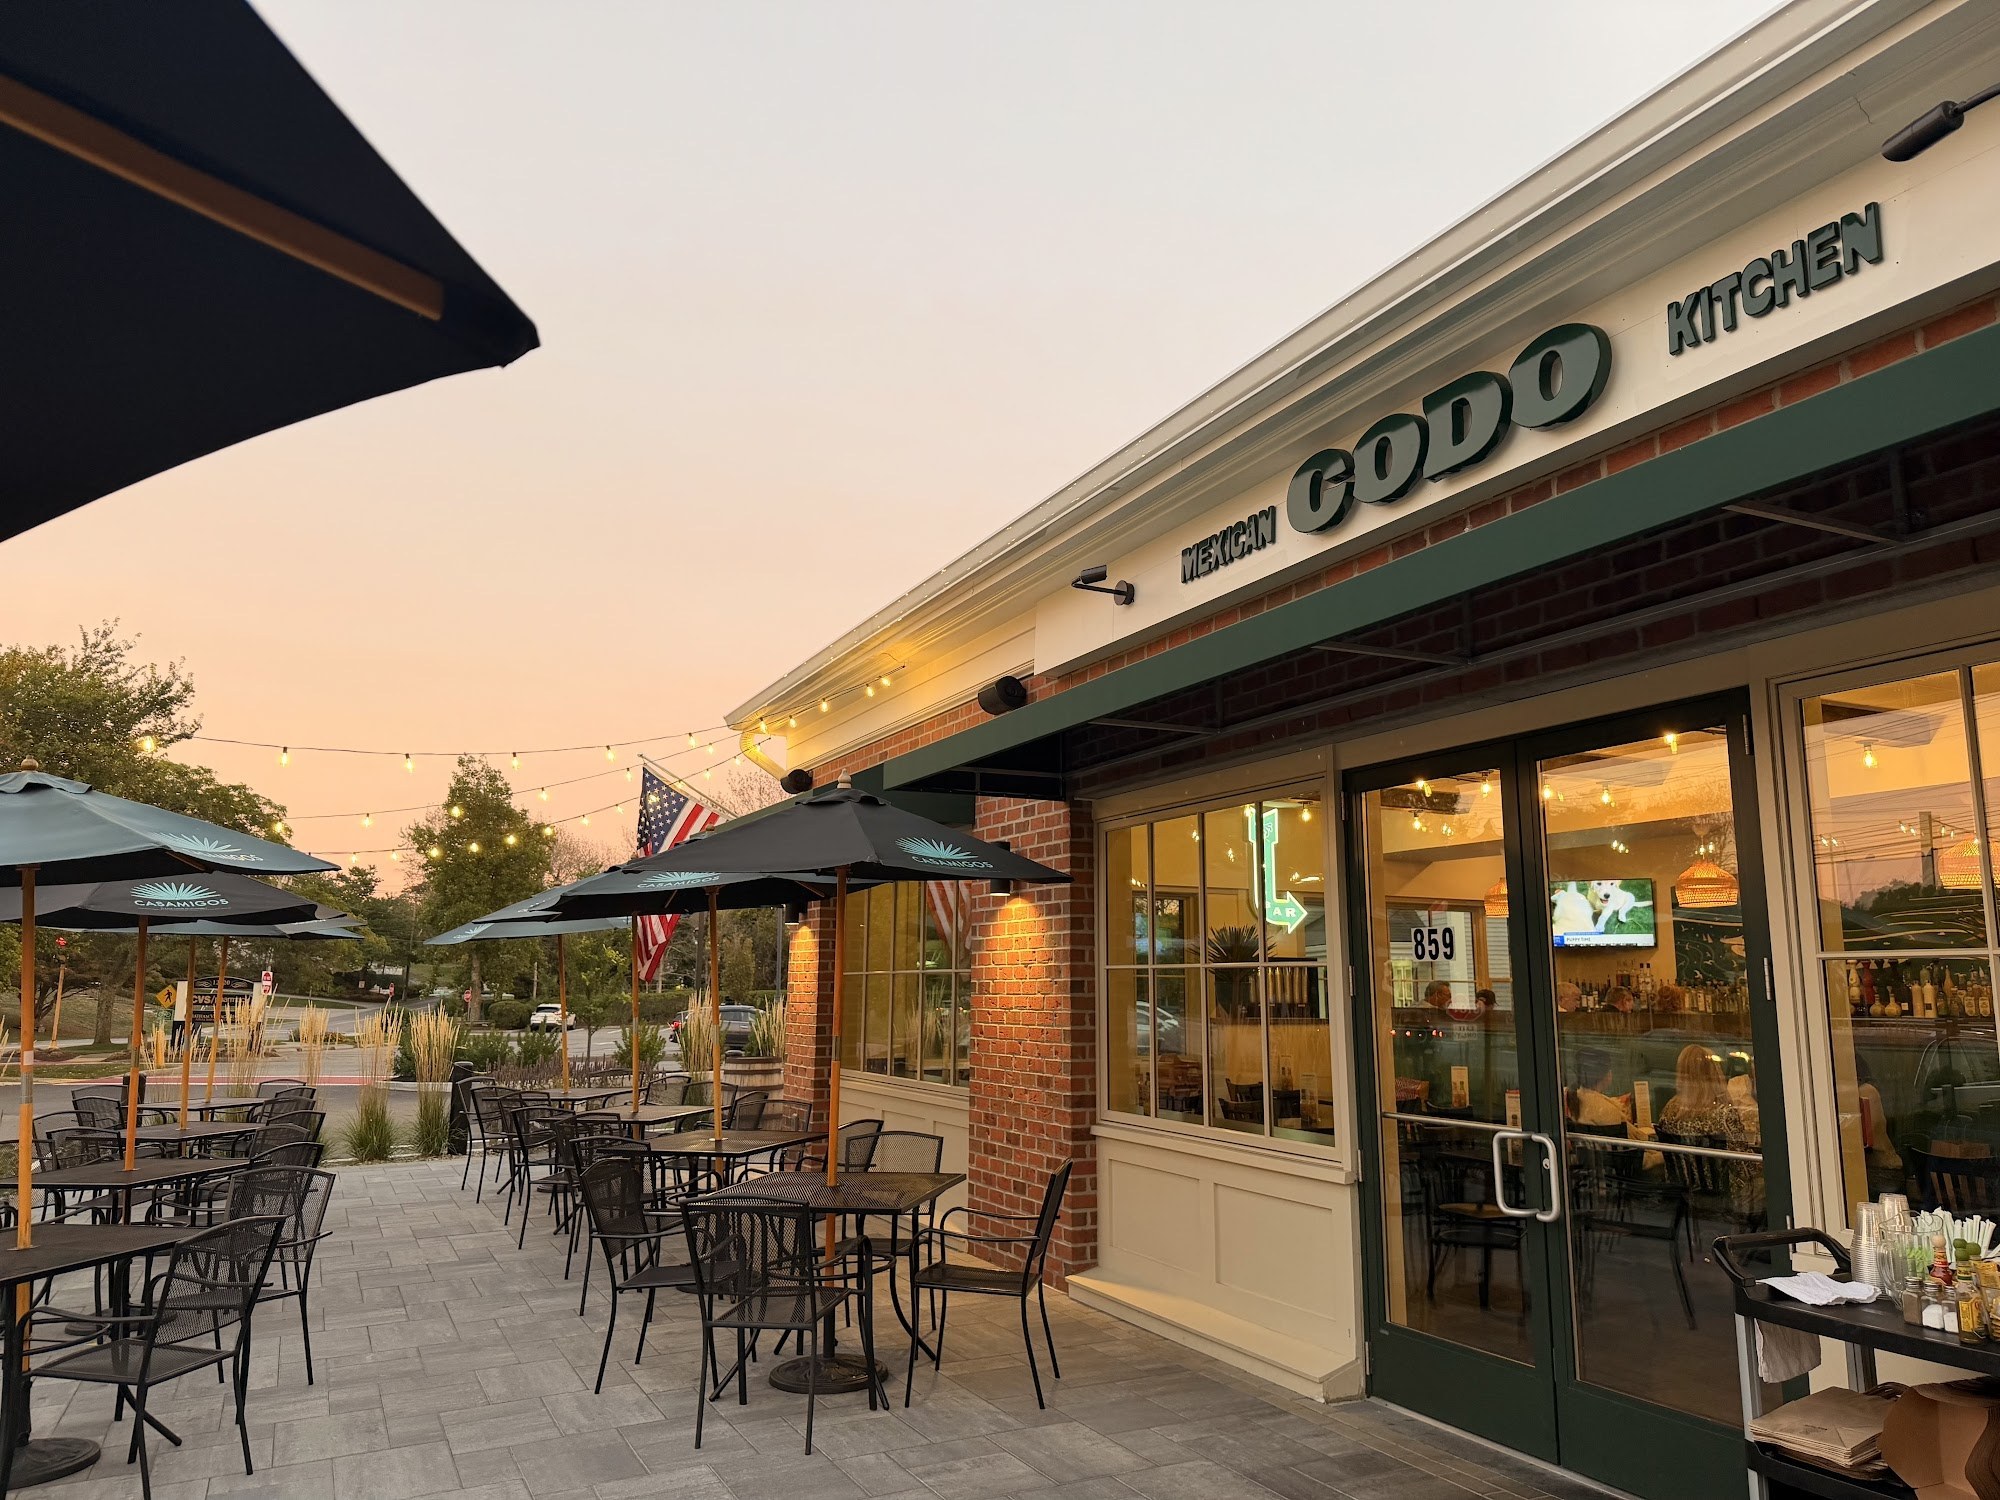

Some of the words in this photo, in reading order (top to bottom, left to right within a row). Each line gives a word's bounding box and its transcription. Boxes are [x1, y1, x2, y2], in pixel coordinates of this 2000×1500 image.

[1181, 506, 1276, 583] MEXICAN
[1286, 322, 1612, 535] CODO
[1667, 202, 1882, 355] KITCHEN
[912, 856, 994, 868] CASAMIGOS
[637, 875, 720, 888] CASAMIGOS
[134, 898, 229, 908] CASAMIGOS
[1413, 927, 1454, 960] 859
